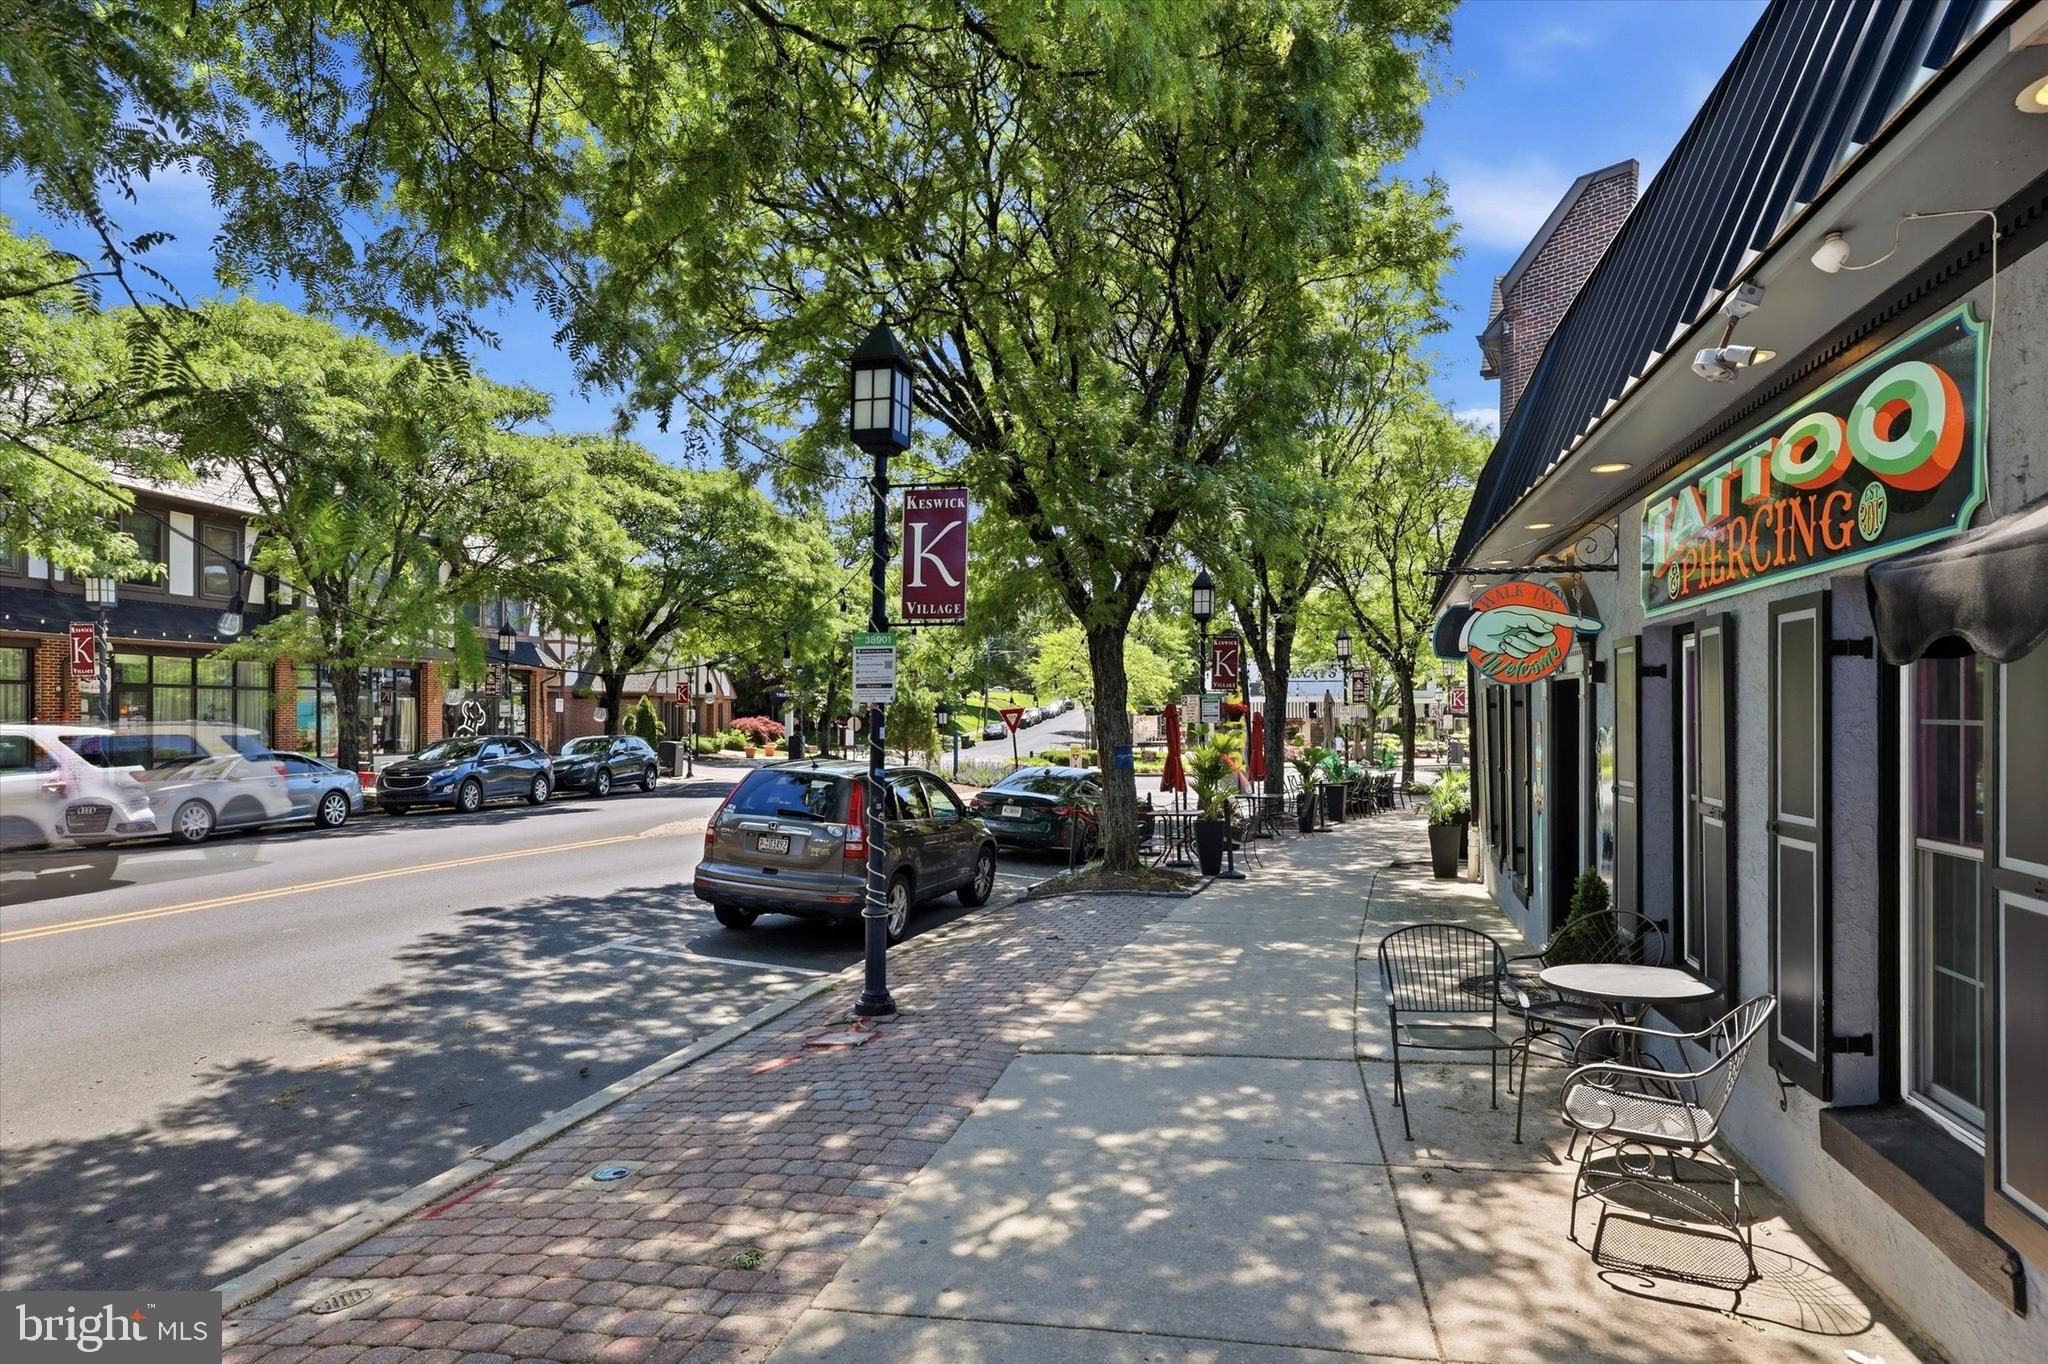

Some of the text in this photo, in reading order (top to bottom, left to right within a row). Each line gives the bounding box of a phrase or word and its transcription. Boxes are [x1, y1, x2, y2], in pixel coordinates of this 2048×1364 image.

[1647, 361, 1965, 578] TATTOO
[906, 495, 965, 510] KESWICK
[1865, 485, 1880, 502] EST
[1860, 497, 1885, 536] 2017
[907, 520, 962, 587] K
[1681, 490, 1855, 595] PIERCING
[906, 601, 962, 614] VILLAGE
[72, 637, 93, 664] K
[864, 635, 892, 644] 38901
[1214, 649, 1236, 677] K
[1478, 645, 1562, 682] Welcome
[677, 687, 688, 701] K
[1452, 691, 1465, 707] K
